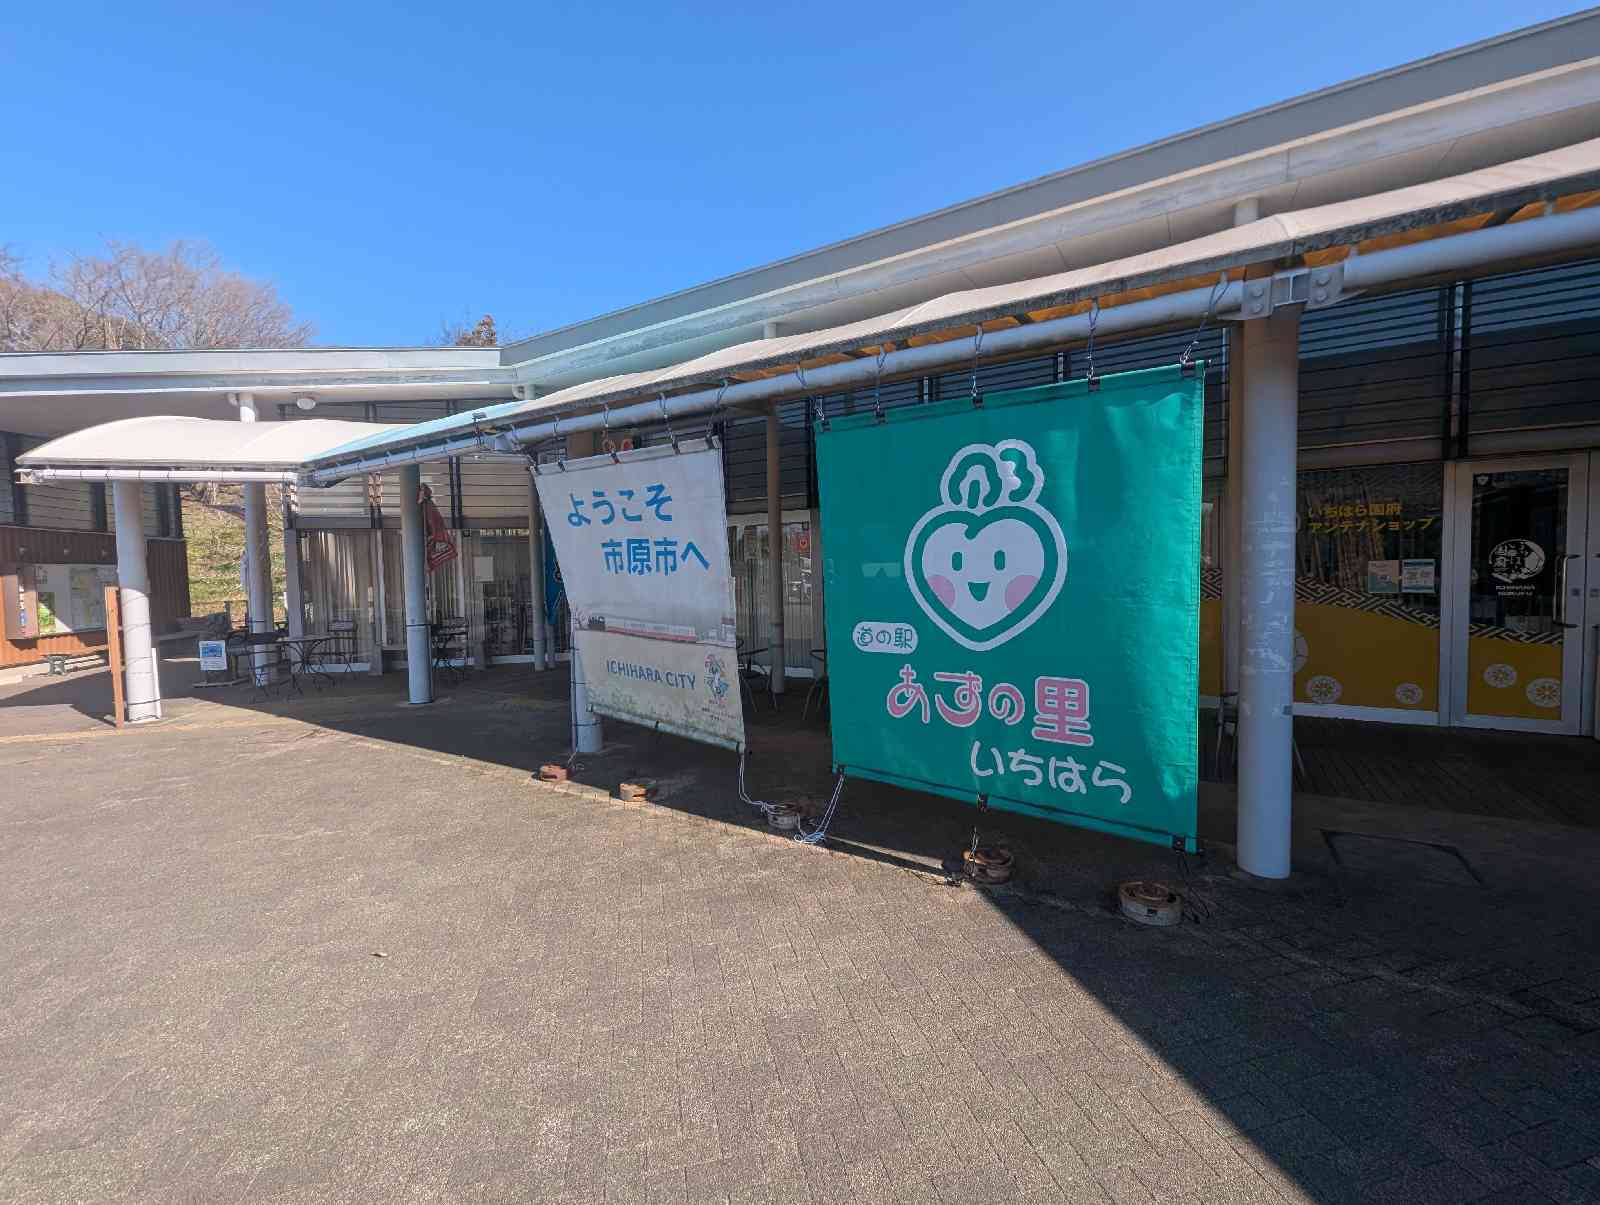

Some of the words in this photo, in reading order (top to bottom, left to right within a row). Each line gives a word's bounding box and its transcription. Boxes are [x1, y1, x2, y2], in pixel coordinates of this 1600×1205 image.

[567, 483, 673, 527] ようこそ
[601, 537, 711, 576] 市原市へ
[856, 626, 914, 650] 道の駅
[606, 659, 662, 682] ICHIHARA
[666, 671, 697, 689] CITY
[886, 663, 1095, 747] あずの里
[970, 740, 1132, 804] いちはら
